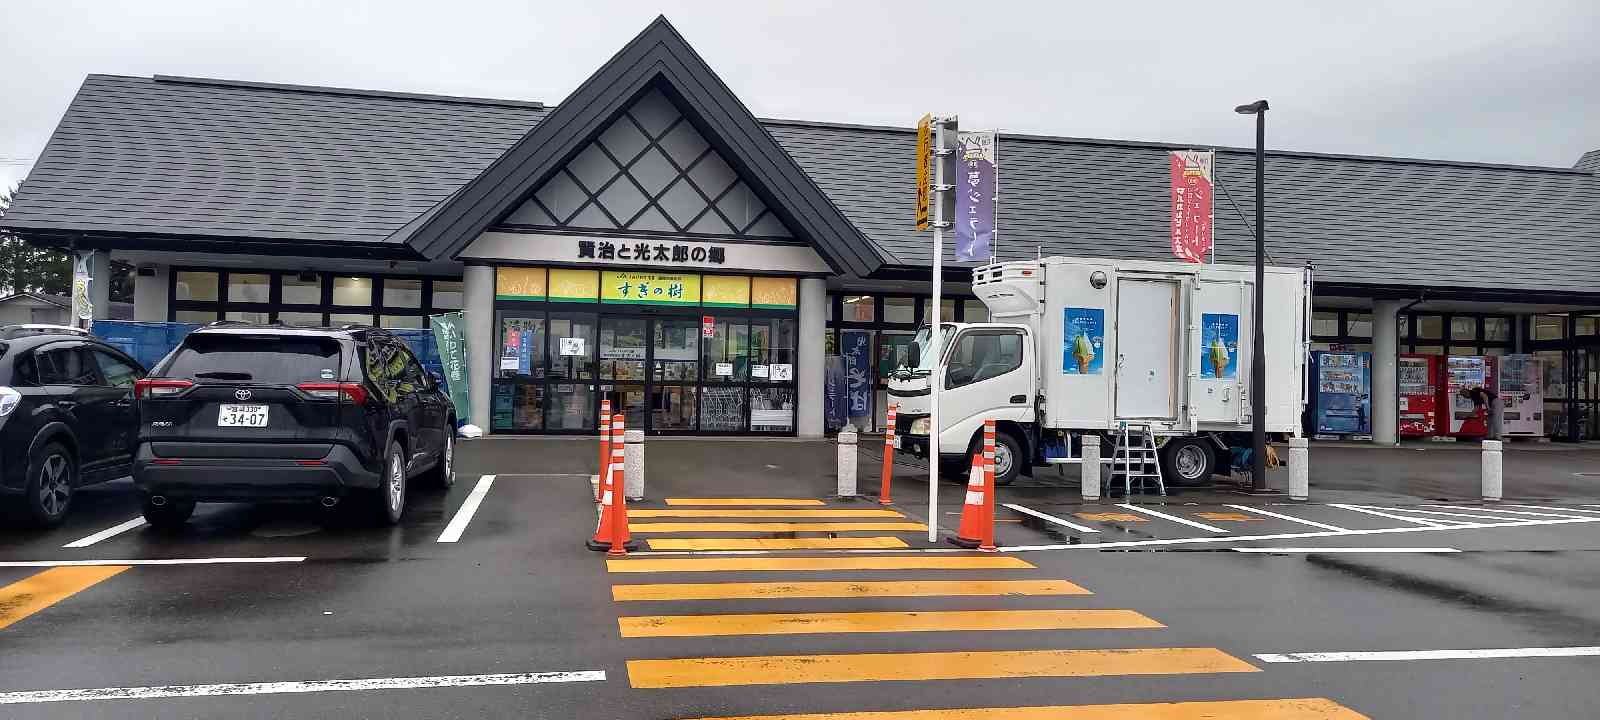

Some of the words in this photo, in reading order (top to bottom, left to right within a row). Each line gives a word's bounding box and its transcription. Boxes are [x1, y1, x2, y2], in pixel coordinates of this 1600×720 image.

[577, 240, 726, 264] 賢治と光太郎の郷
[618, 281, 684, 299] すぎの樹
[229, 413, 265, 426] 34-07
